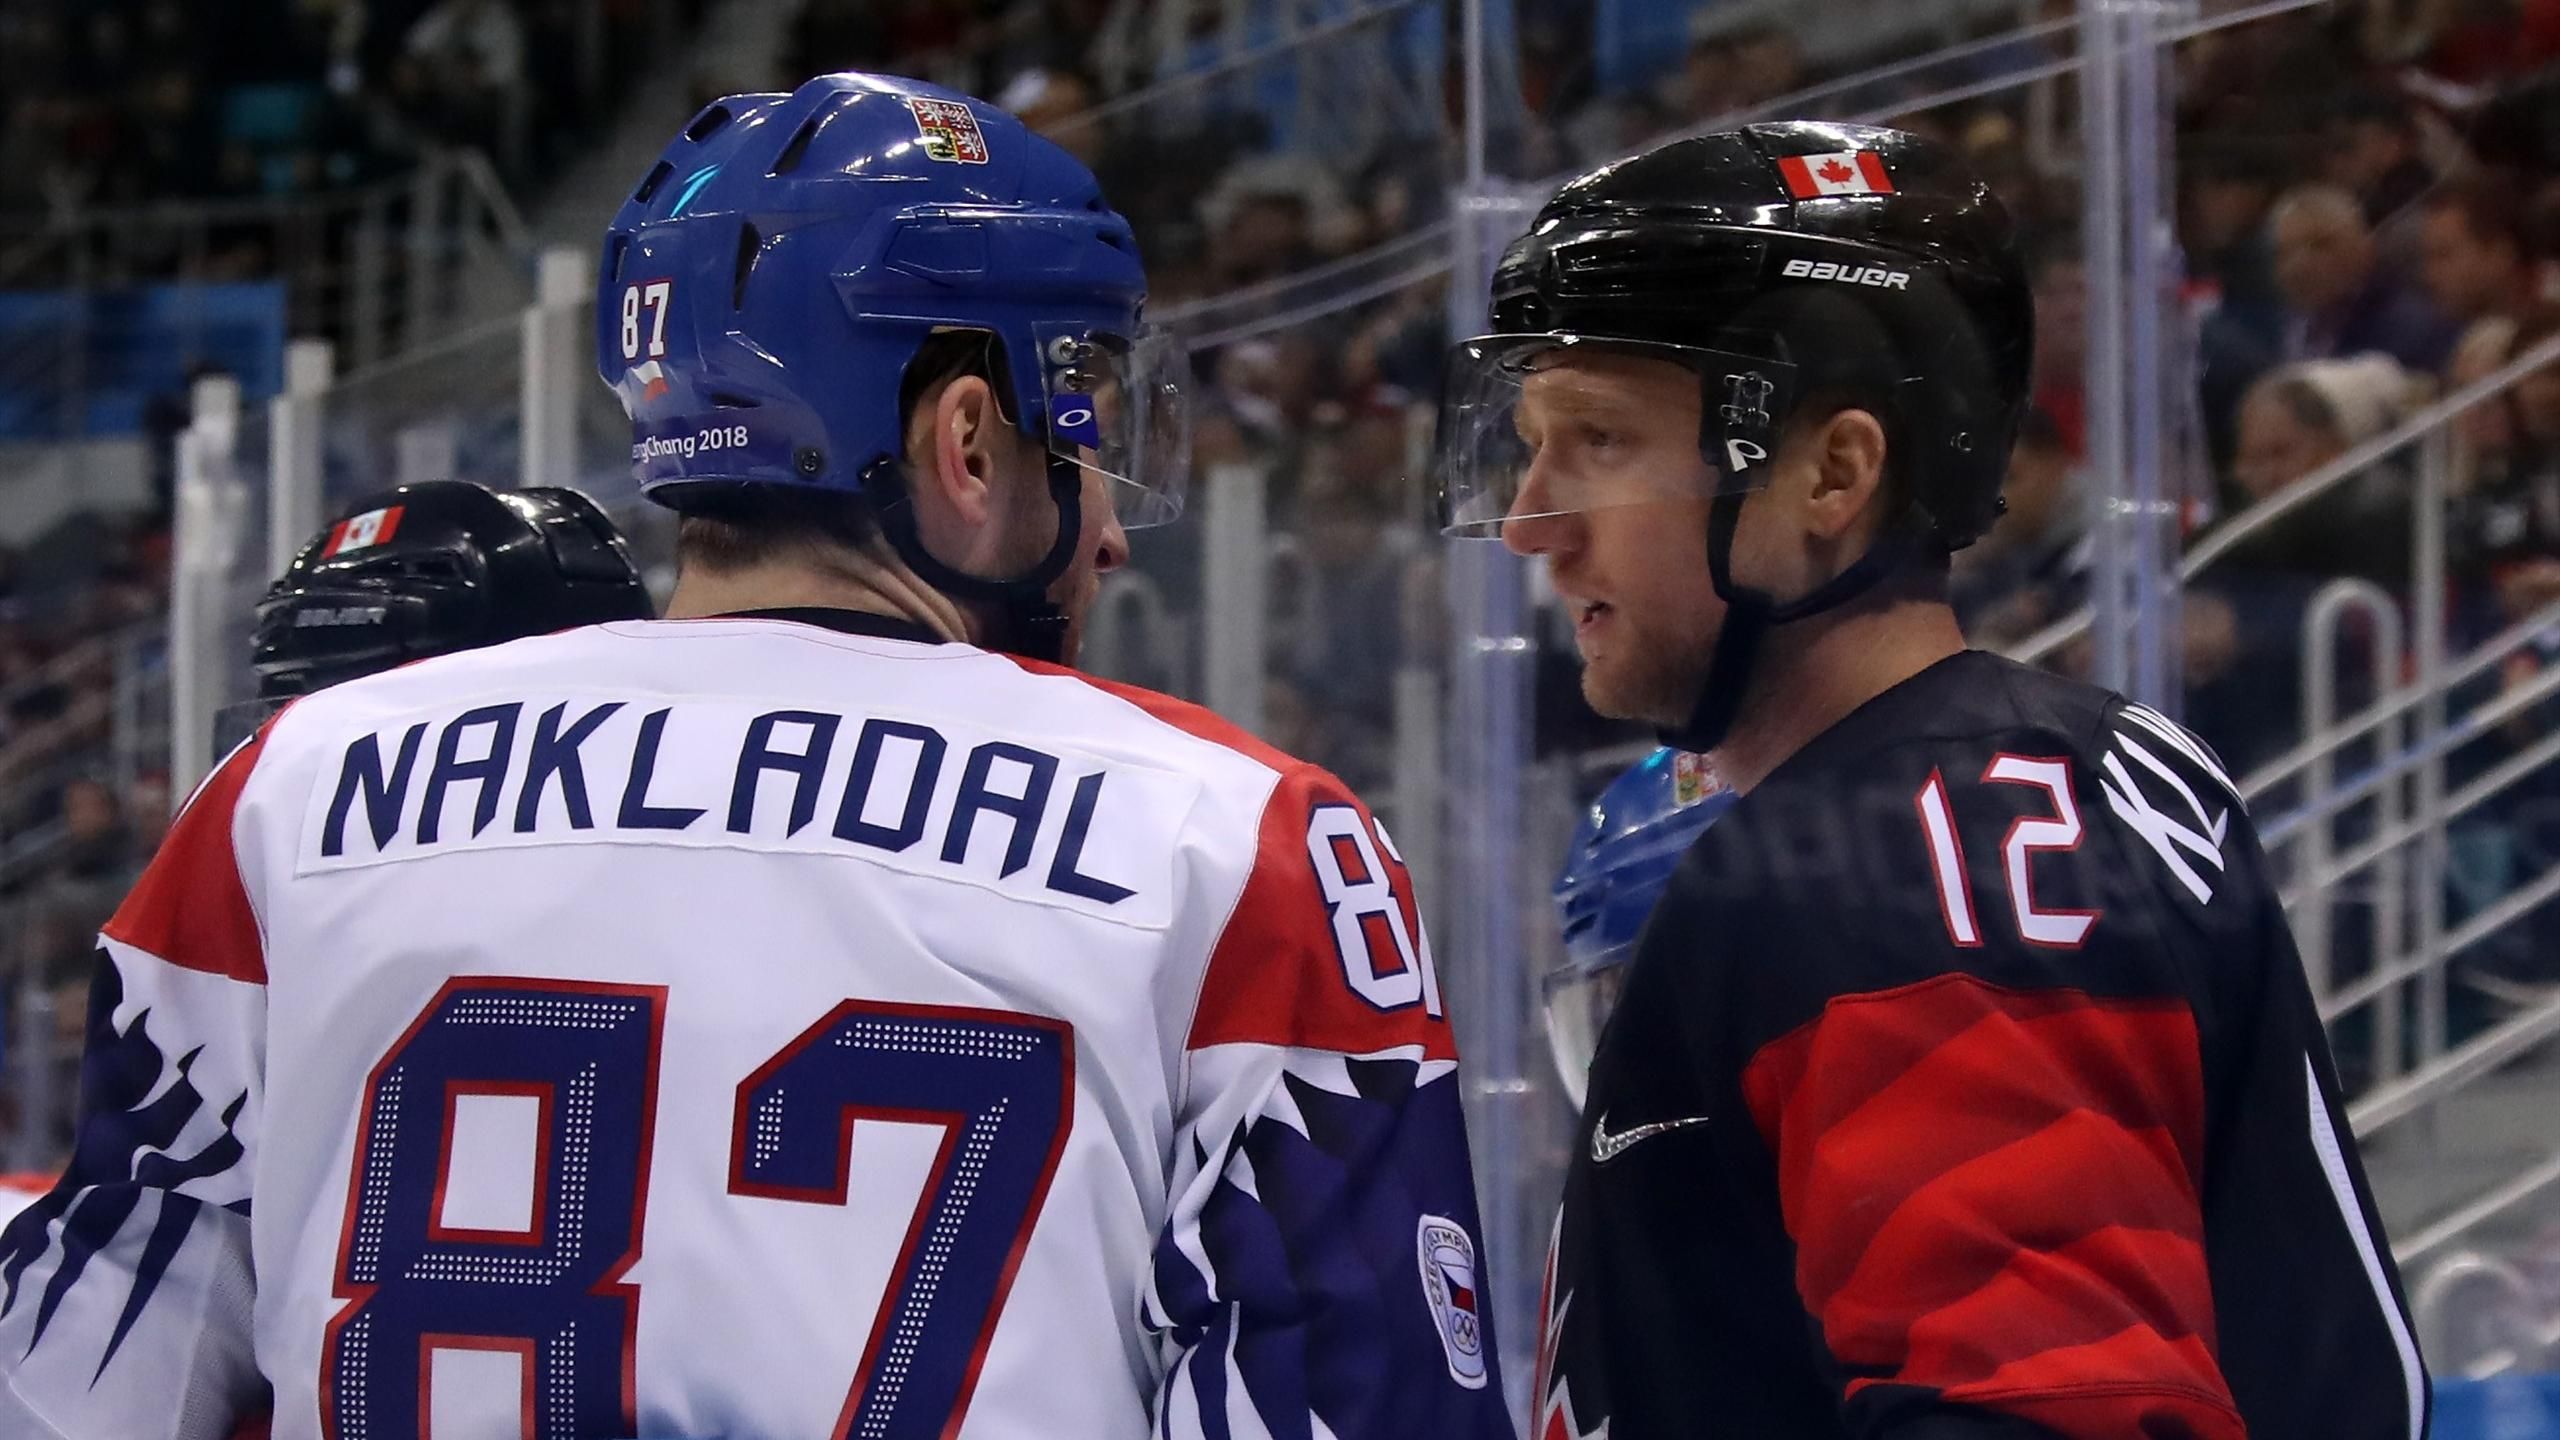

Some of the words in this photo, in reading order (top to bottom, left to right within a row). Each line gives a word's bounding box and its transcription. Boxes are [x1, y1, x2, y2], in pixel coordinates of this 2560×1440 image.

[621, 278, 671, 362] 87
[1781, 258, 1911, 291] BAUER
[699, 425, 749, 451] 2018
[321, 701, 1140, 905] NAKLADAL
[1914, 751, 2104, 950] 12
[319, 975, 1076, 1440] 87
